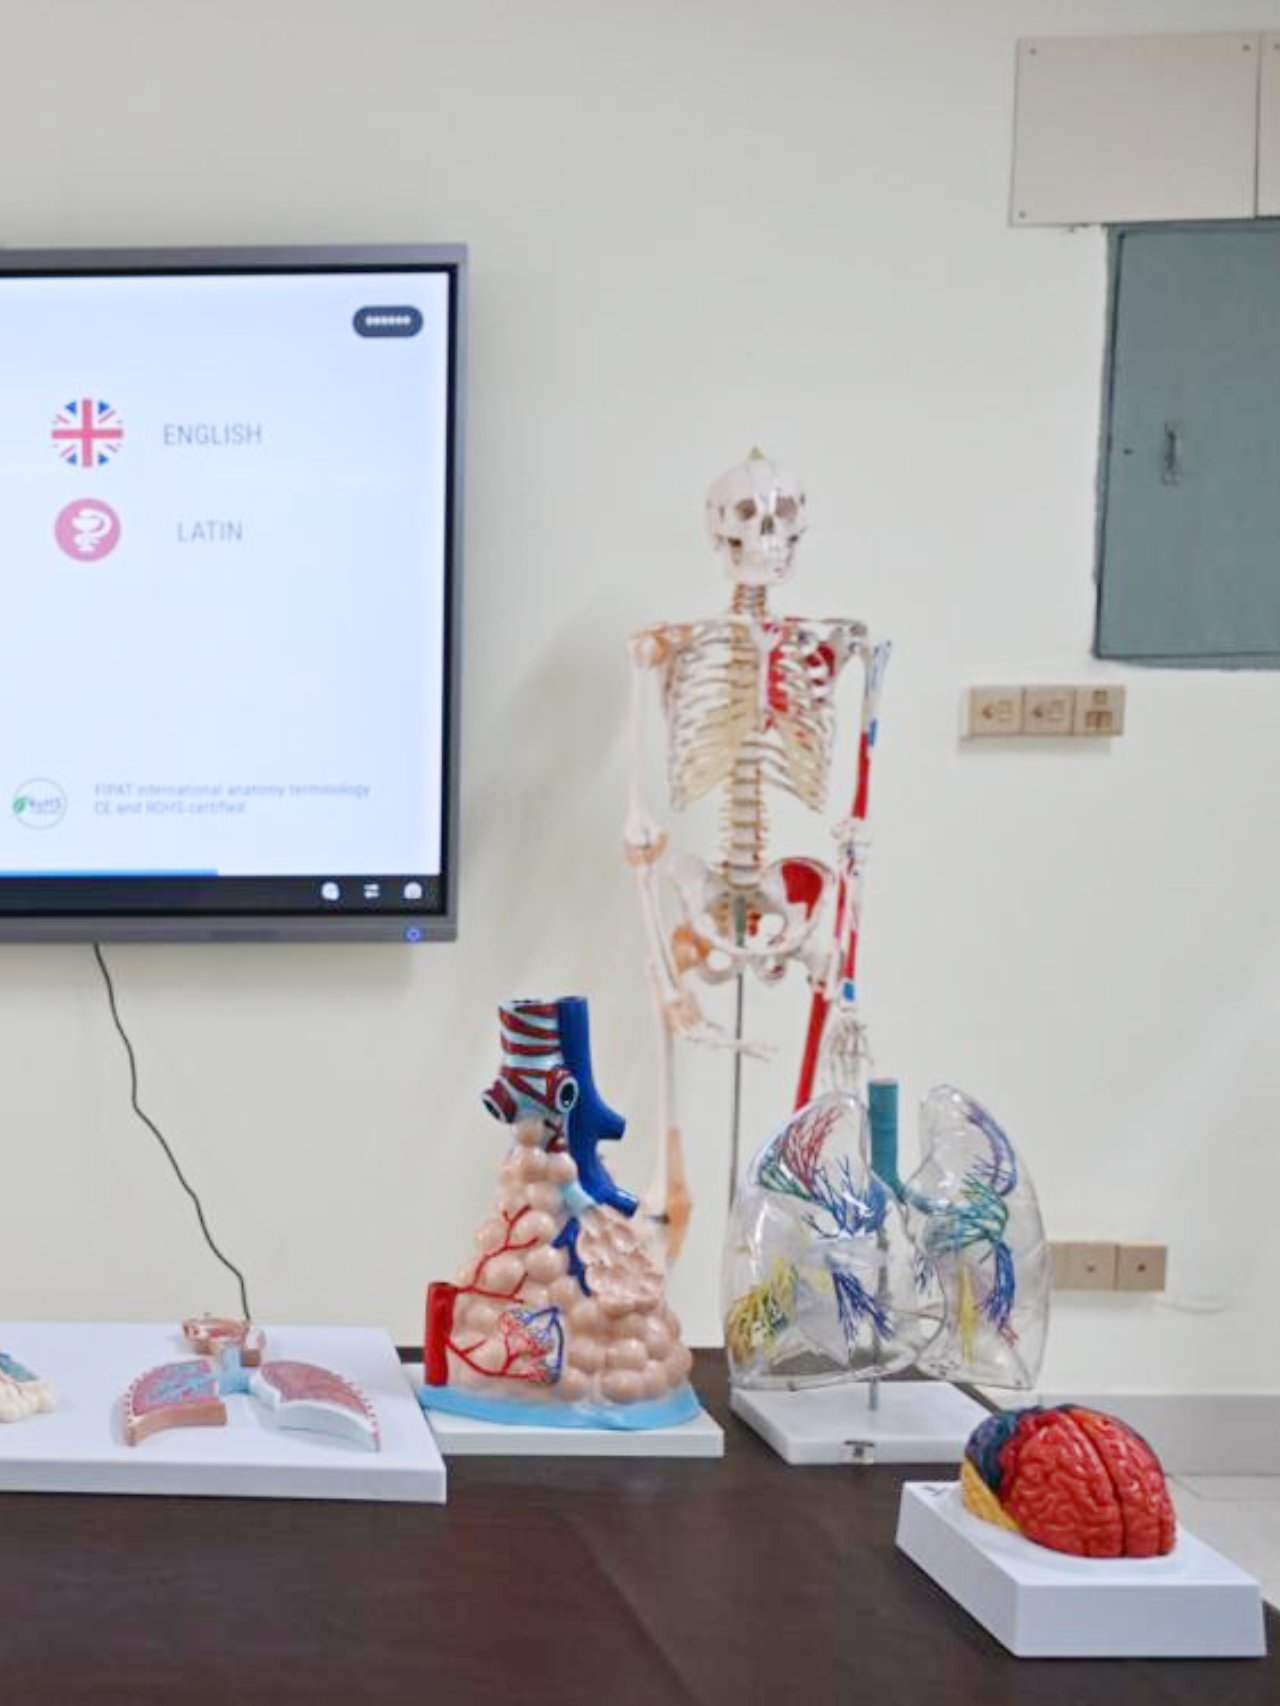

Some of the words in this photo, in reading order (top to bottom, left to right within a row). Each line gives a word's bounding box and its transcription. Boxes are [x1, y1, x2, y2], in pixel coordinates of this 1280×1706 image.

[163, 422, 262, 446] ENGLISH
[177, 519, 242, 542] LATIN
[116, 801, 141, 815] and
